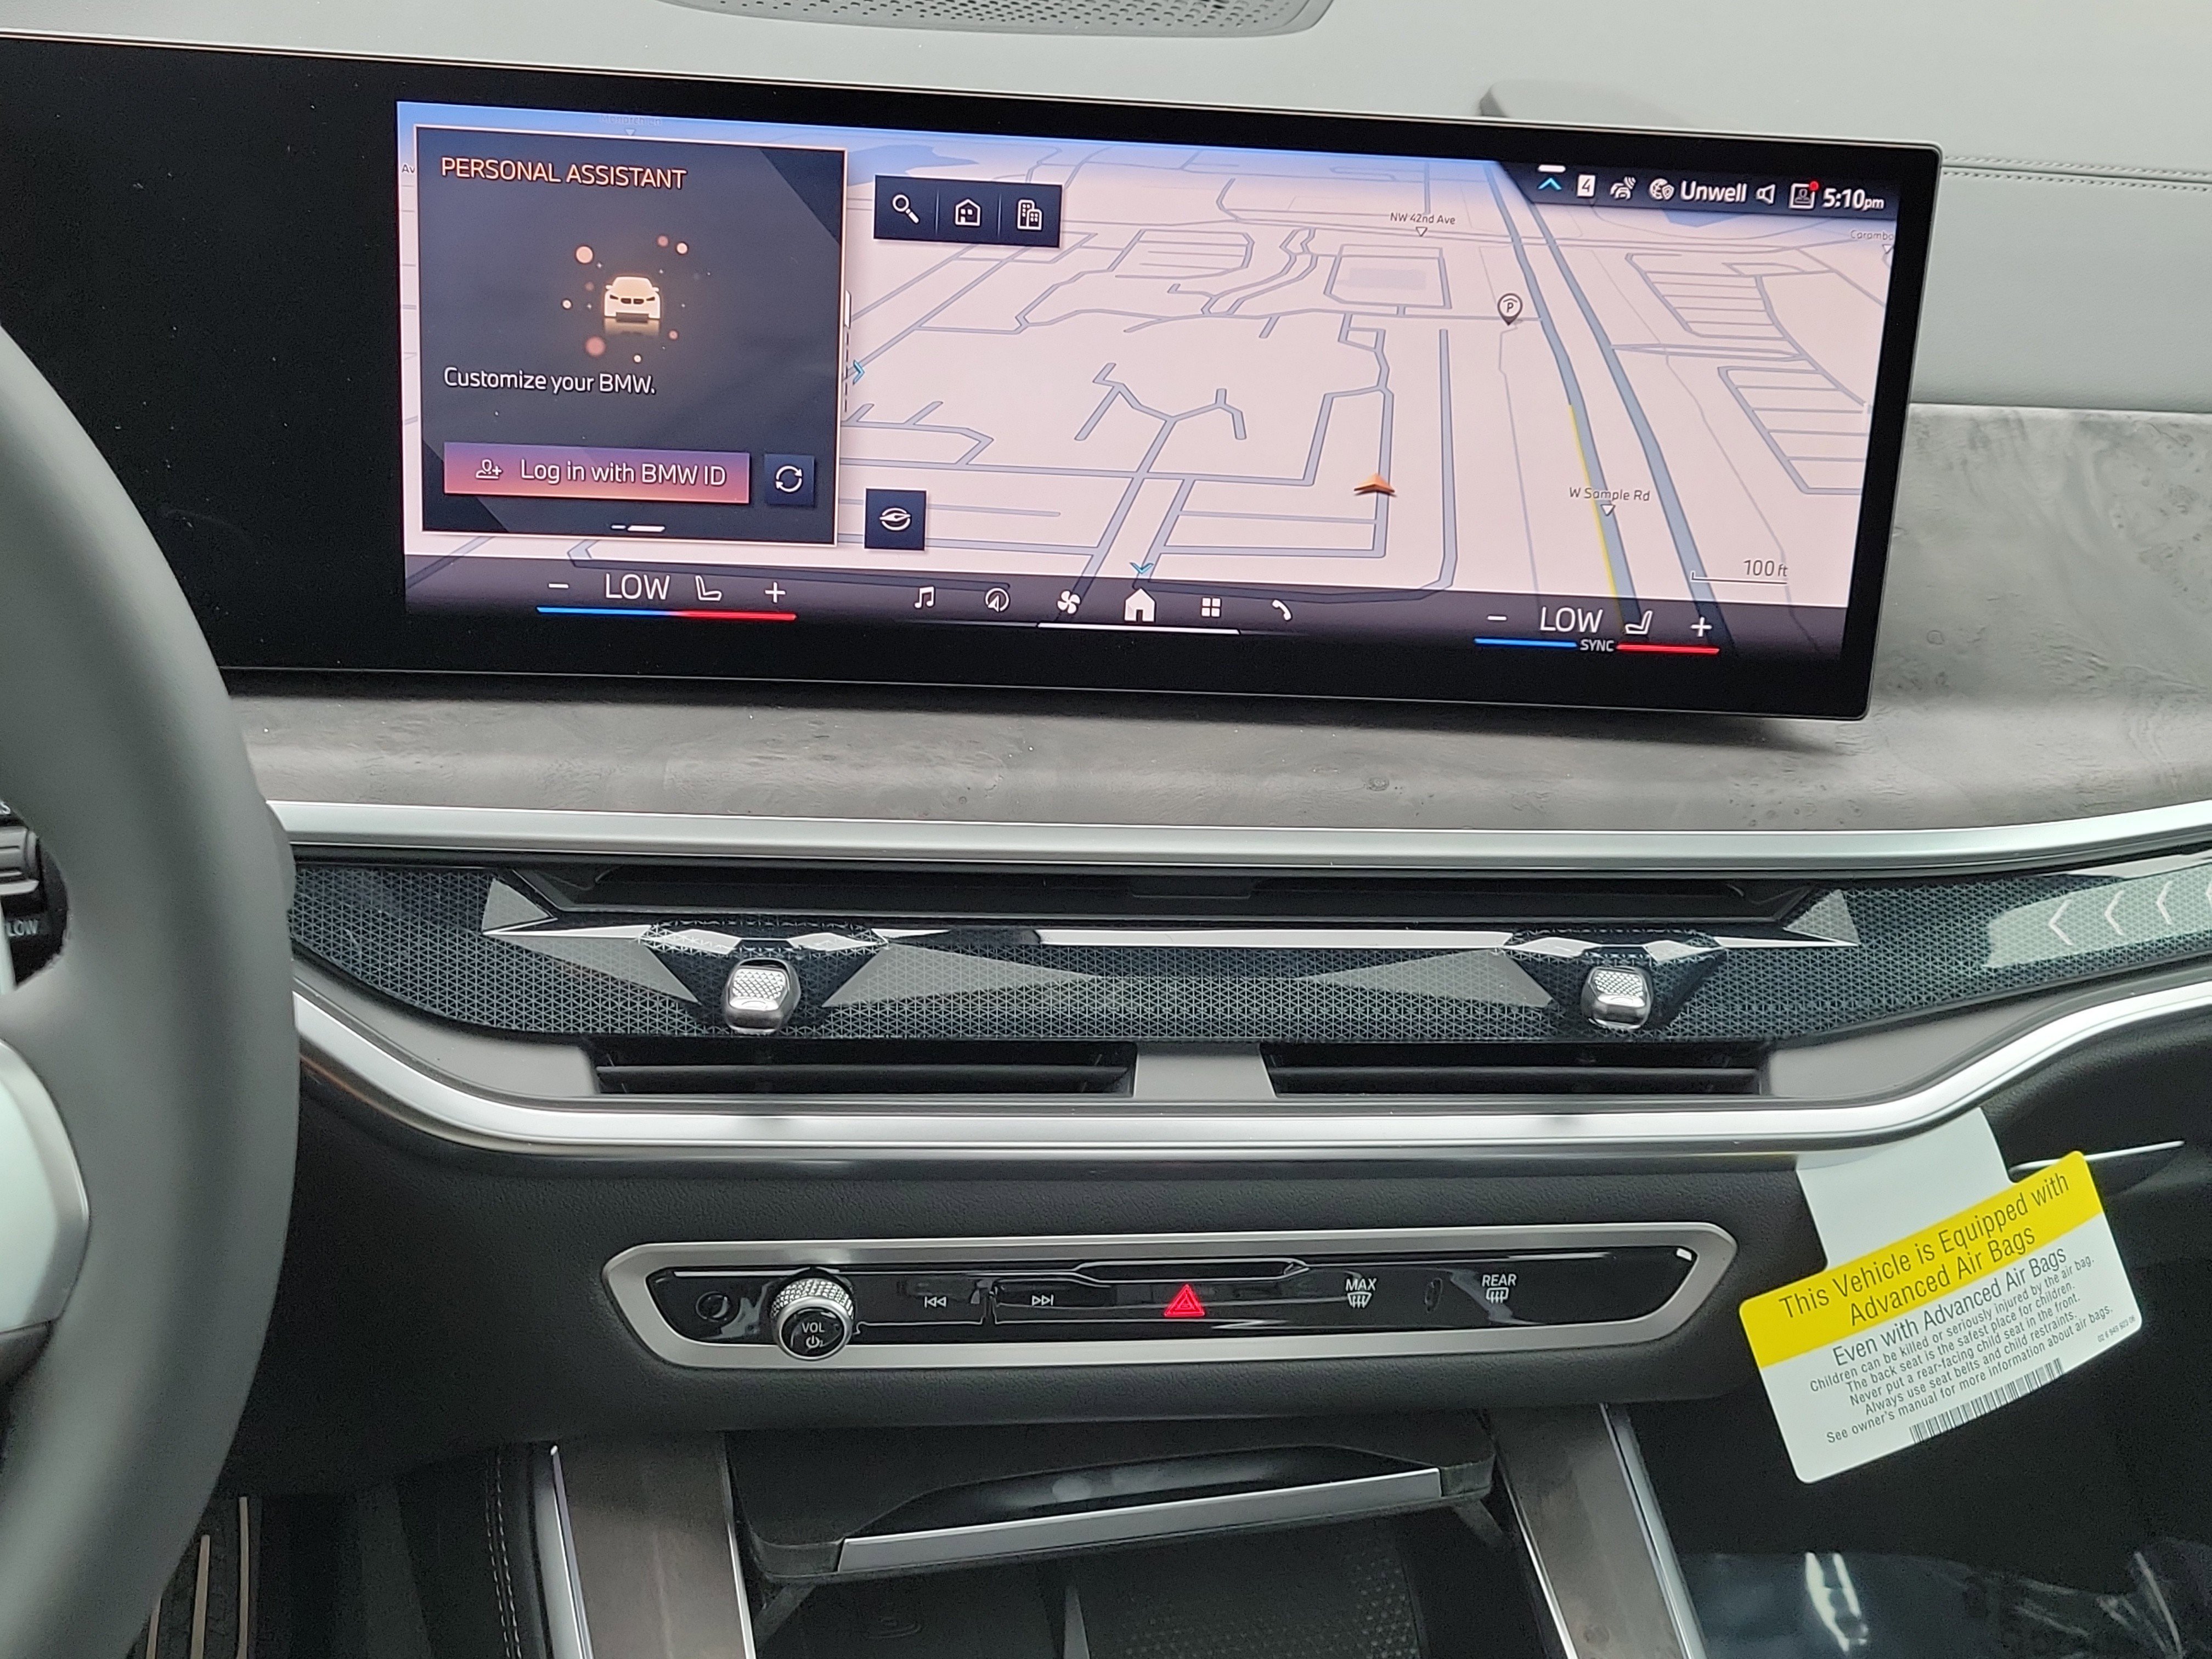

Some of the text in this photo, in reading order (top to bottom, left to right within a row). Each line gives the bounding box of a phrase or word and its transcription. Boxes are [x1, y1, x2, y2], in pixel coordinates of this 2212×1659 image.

[441, 157, 687, 190] PERSONAL ASSISTANT
[1581, 178, 1592, 194] 4
[1680, 180, 1747, 203] Unwell
[1821, 188, 1884, 211] 5:10pm
[1390, 212, 1455, 225] NW 42nd Ave
[444, 366, 657, 395] Customize your BMW.
[520, 458, 727, 486] Log in with BMW ID
[1569, 487, 1651, 501] W Sample Rd
[1743, 558, 1788, 577] 100 ft
[604, 573, 670, 600] LOW
[1539, 607, 1604, 634] LOW
[1579, 638, 1615, 653] SYNC
[1779, 1173, 2069, 1318] This Vehicle is Equipped with
[1345, 1277, 1377, 1291] MAX
[1482, 1273, 1517, 1287] REAR
[1850, 1227, 2035, 1327] Advanced Air Bags
[1832, 1248, 2067, 1367] Even with Advanced Air Bags
[801, 1322, 825, 1333] VOL
[1810, 1256, 2095, 1392] Children can be killed or seriously injured by the air bag.
[1846, 1282, 2075, 1392] The back seat is the safest place for children.
[1850, 1293, 2080, 1406] Never put a rear-facing child seat in the front.
[1865, 1311, 2077, 1415] Always use seat belts and child restraints.
[1826, 1306, 2113, 1443] See owner's manual for more information about air bags.
